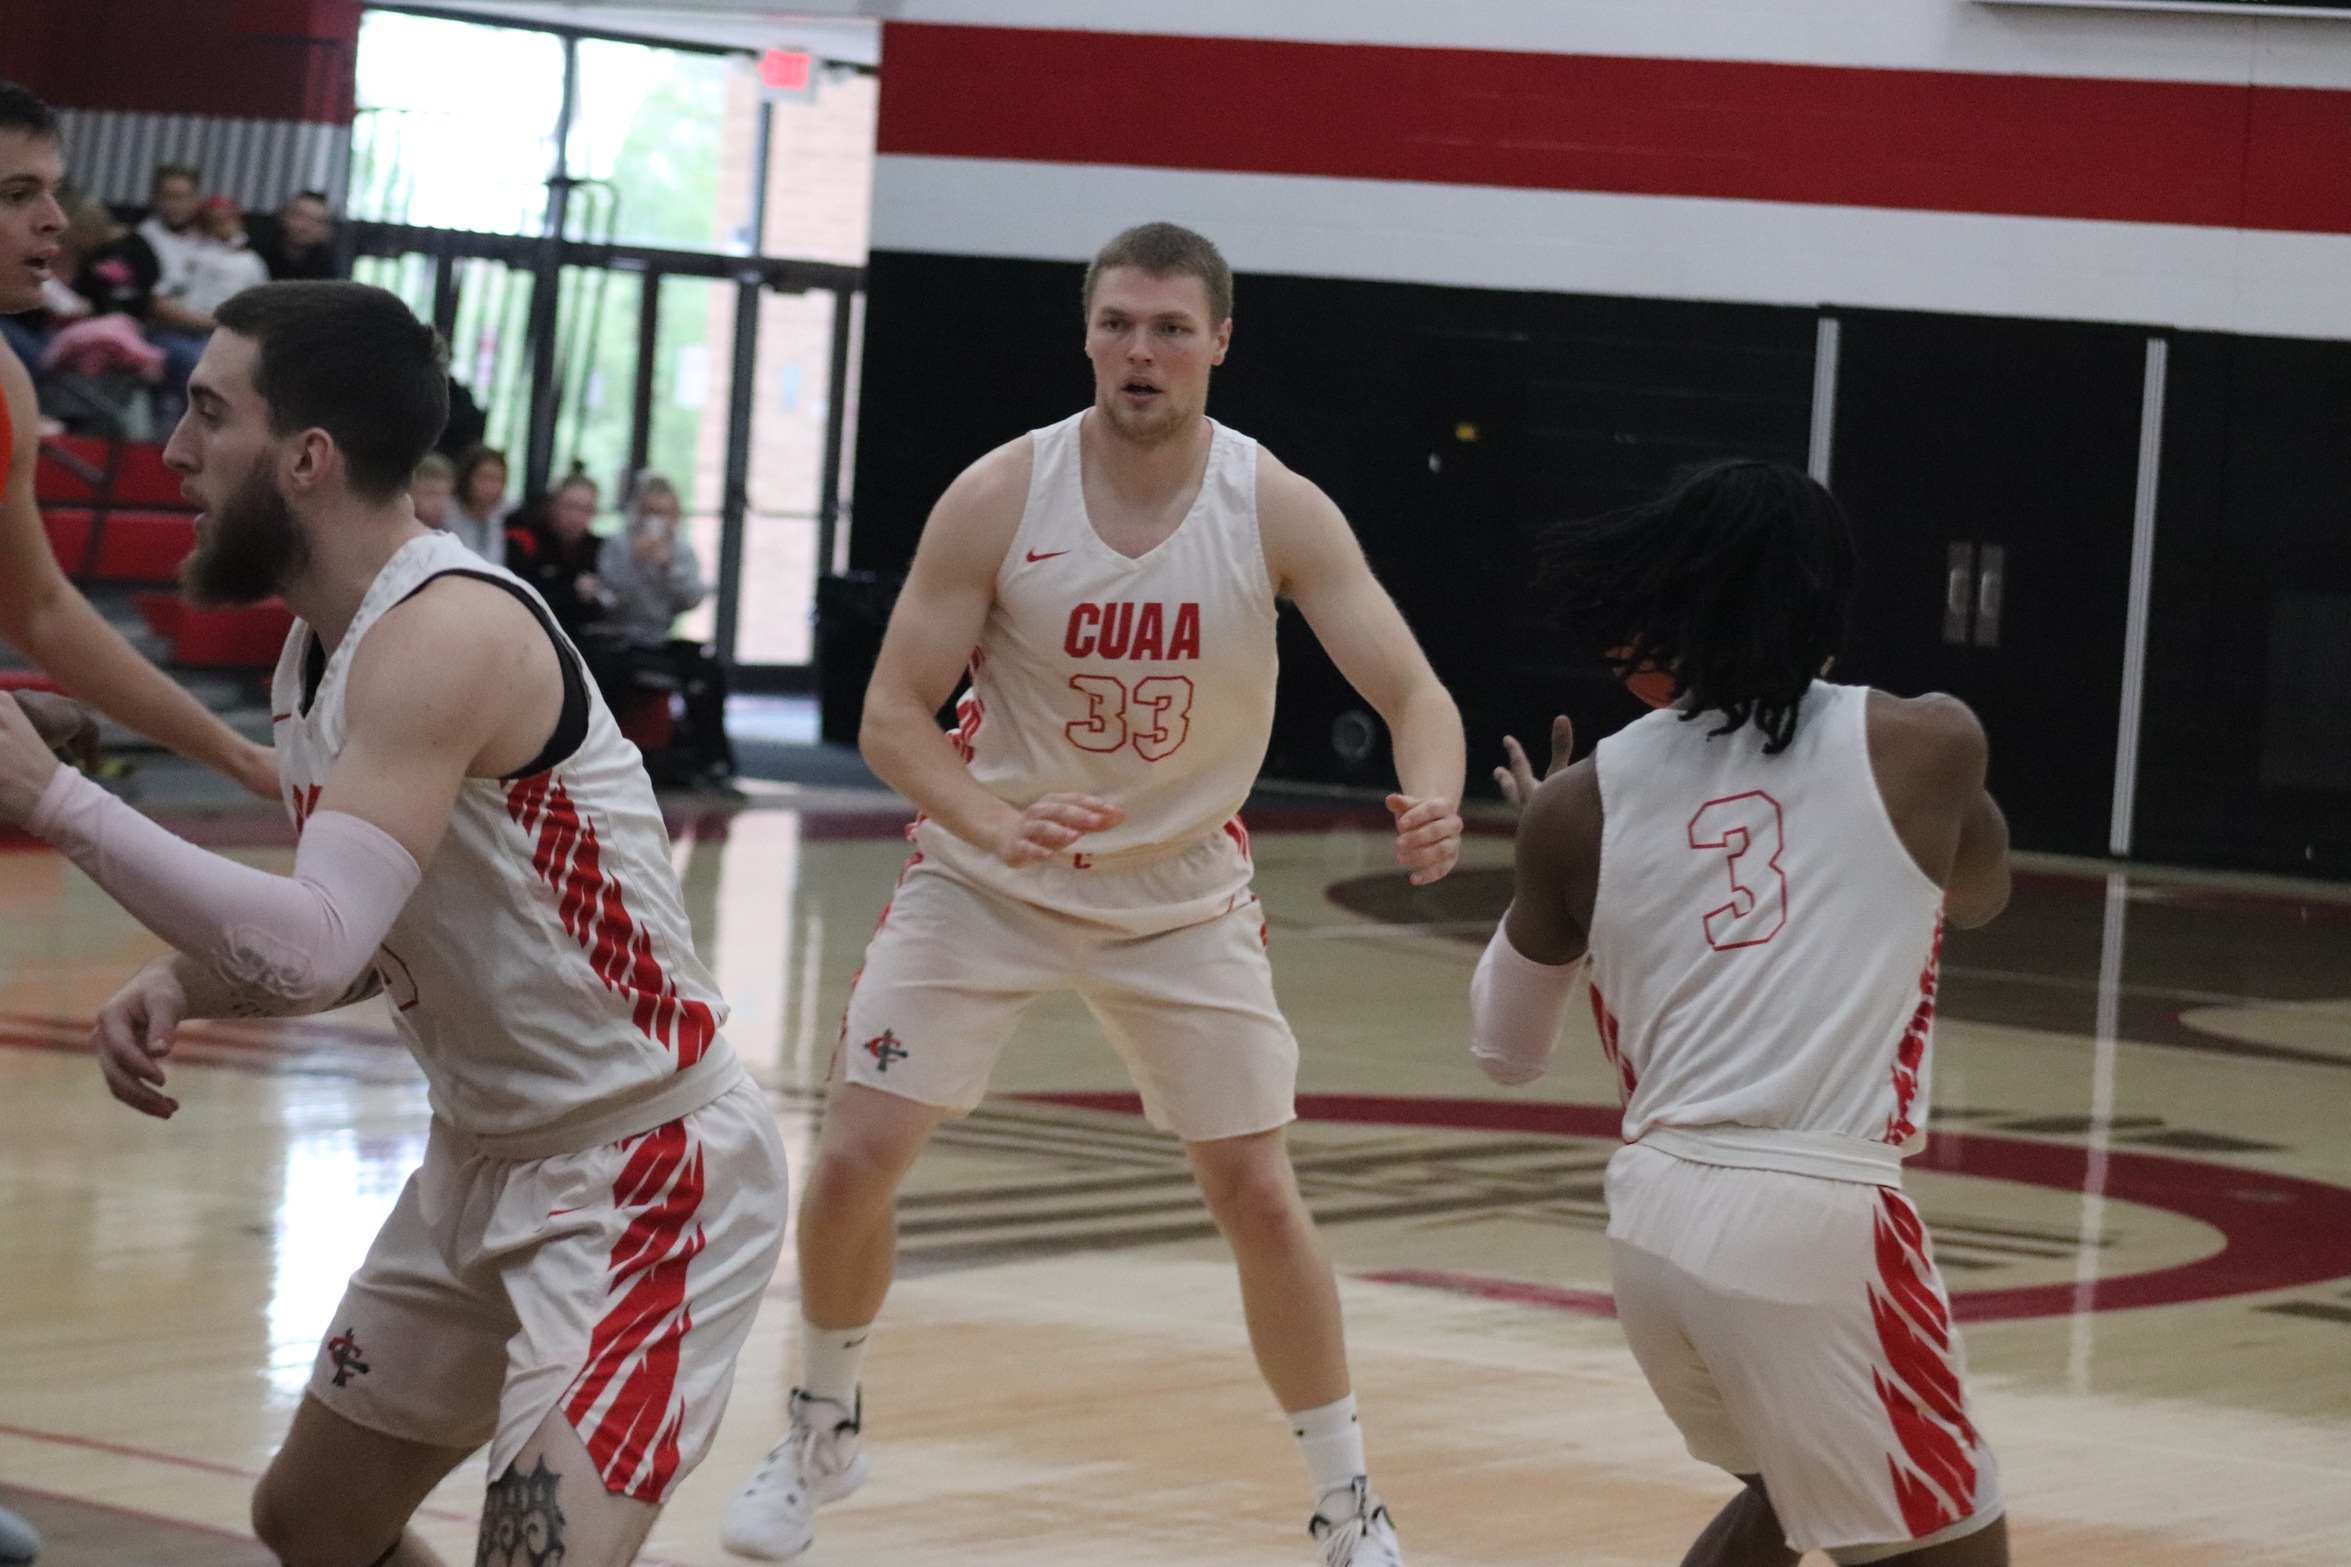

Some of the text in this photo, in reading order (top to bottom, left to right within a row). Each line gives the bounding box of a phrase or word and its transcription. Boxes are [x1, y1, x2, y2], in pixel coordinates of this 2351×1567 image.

[1064, 602, 1200, 660] CUAA
[1065, 674, 1195, 762] 33
[1688, 790, 1786, 951] 3
